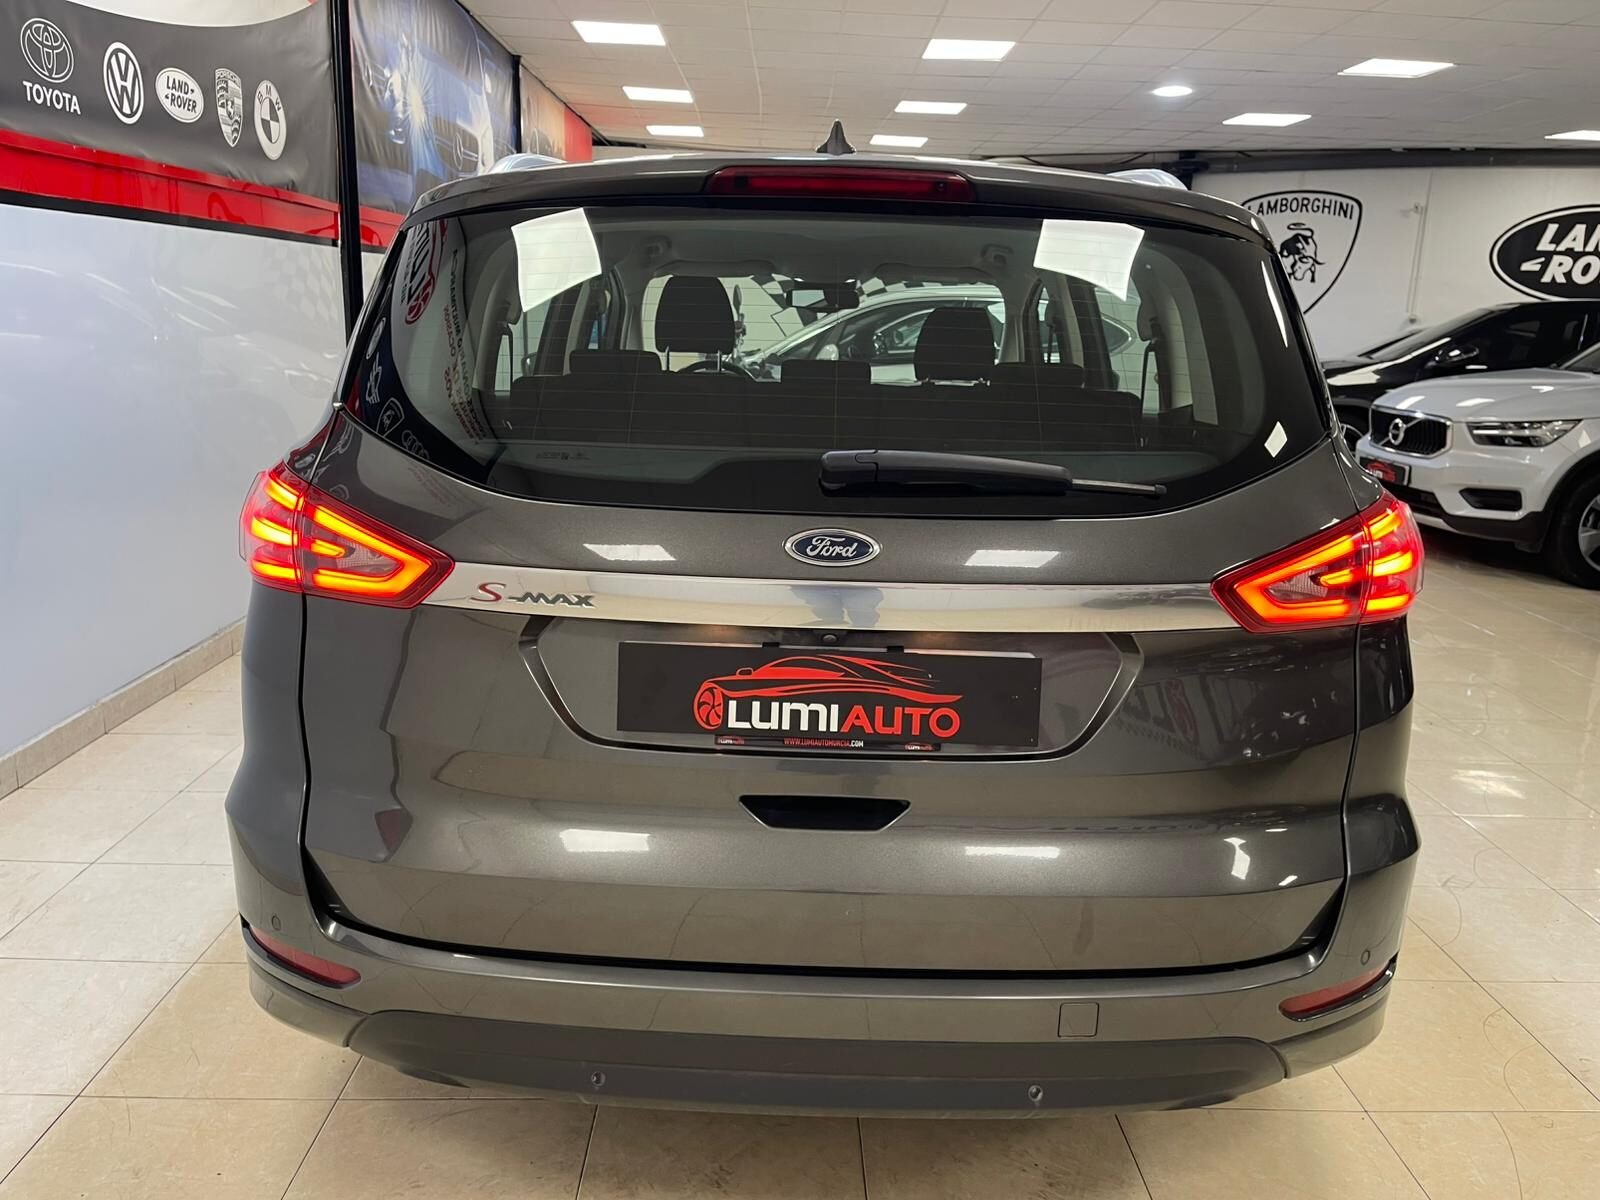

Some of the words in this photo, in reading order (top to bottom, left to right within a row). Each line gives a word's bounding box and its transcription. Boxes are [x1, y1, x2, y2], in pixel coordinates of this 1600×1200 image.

[166, 75, 190, 94] LAND
[22, 80, 81, 115] TOYOTA
[170, 94, 197, 114] ROVER
[1247, 197, 1354, 220] AMBORGHINI
[806, 536, 858, 557] Ford
[470, 582, 595, 608] S-MAX
